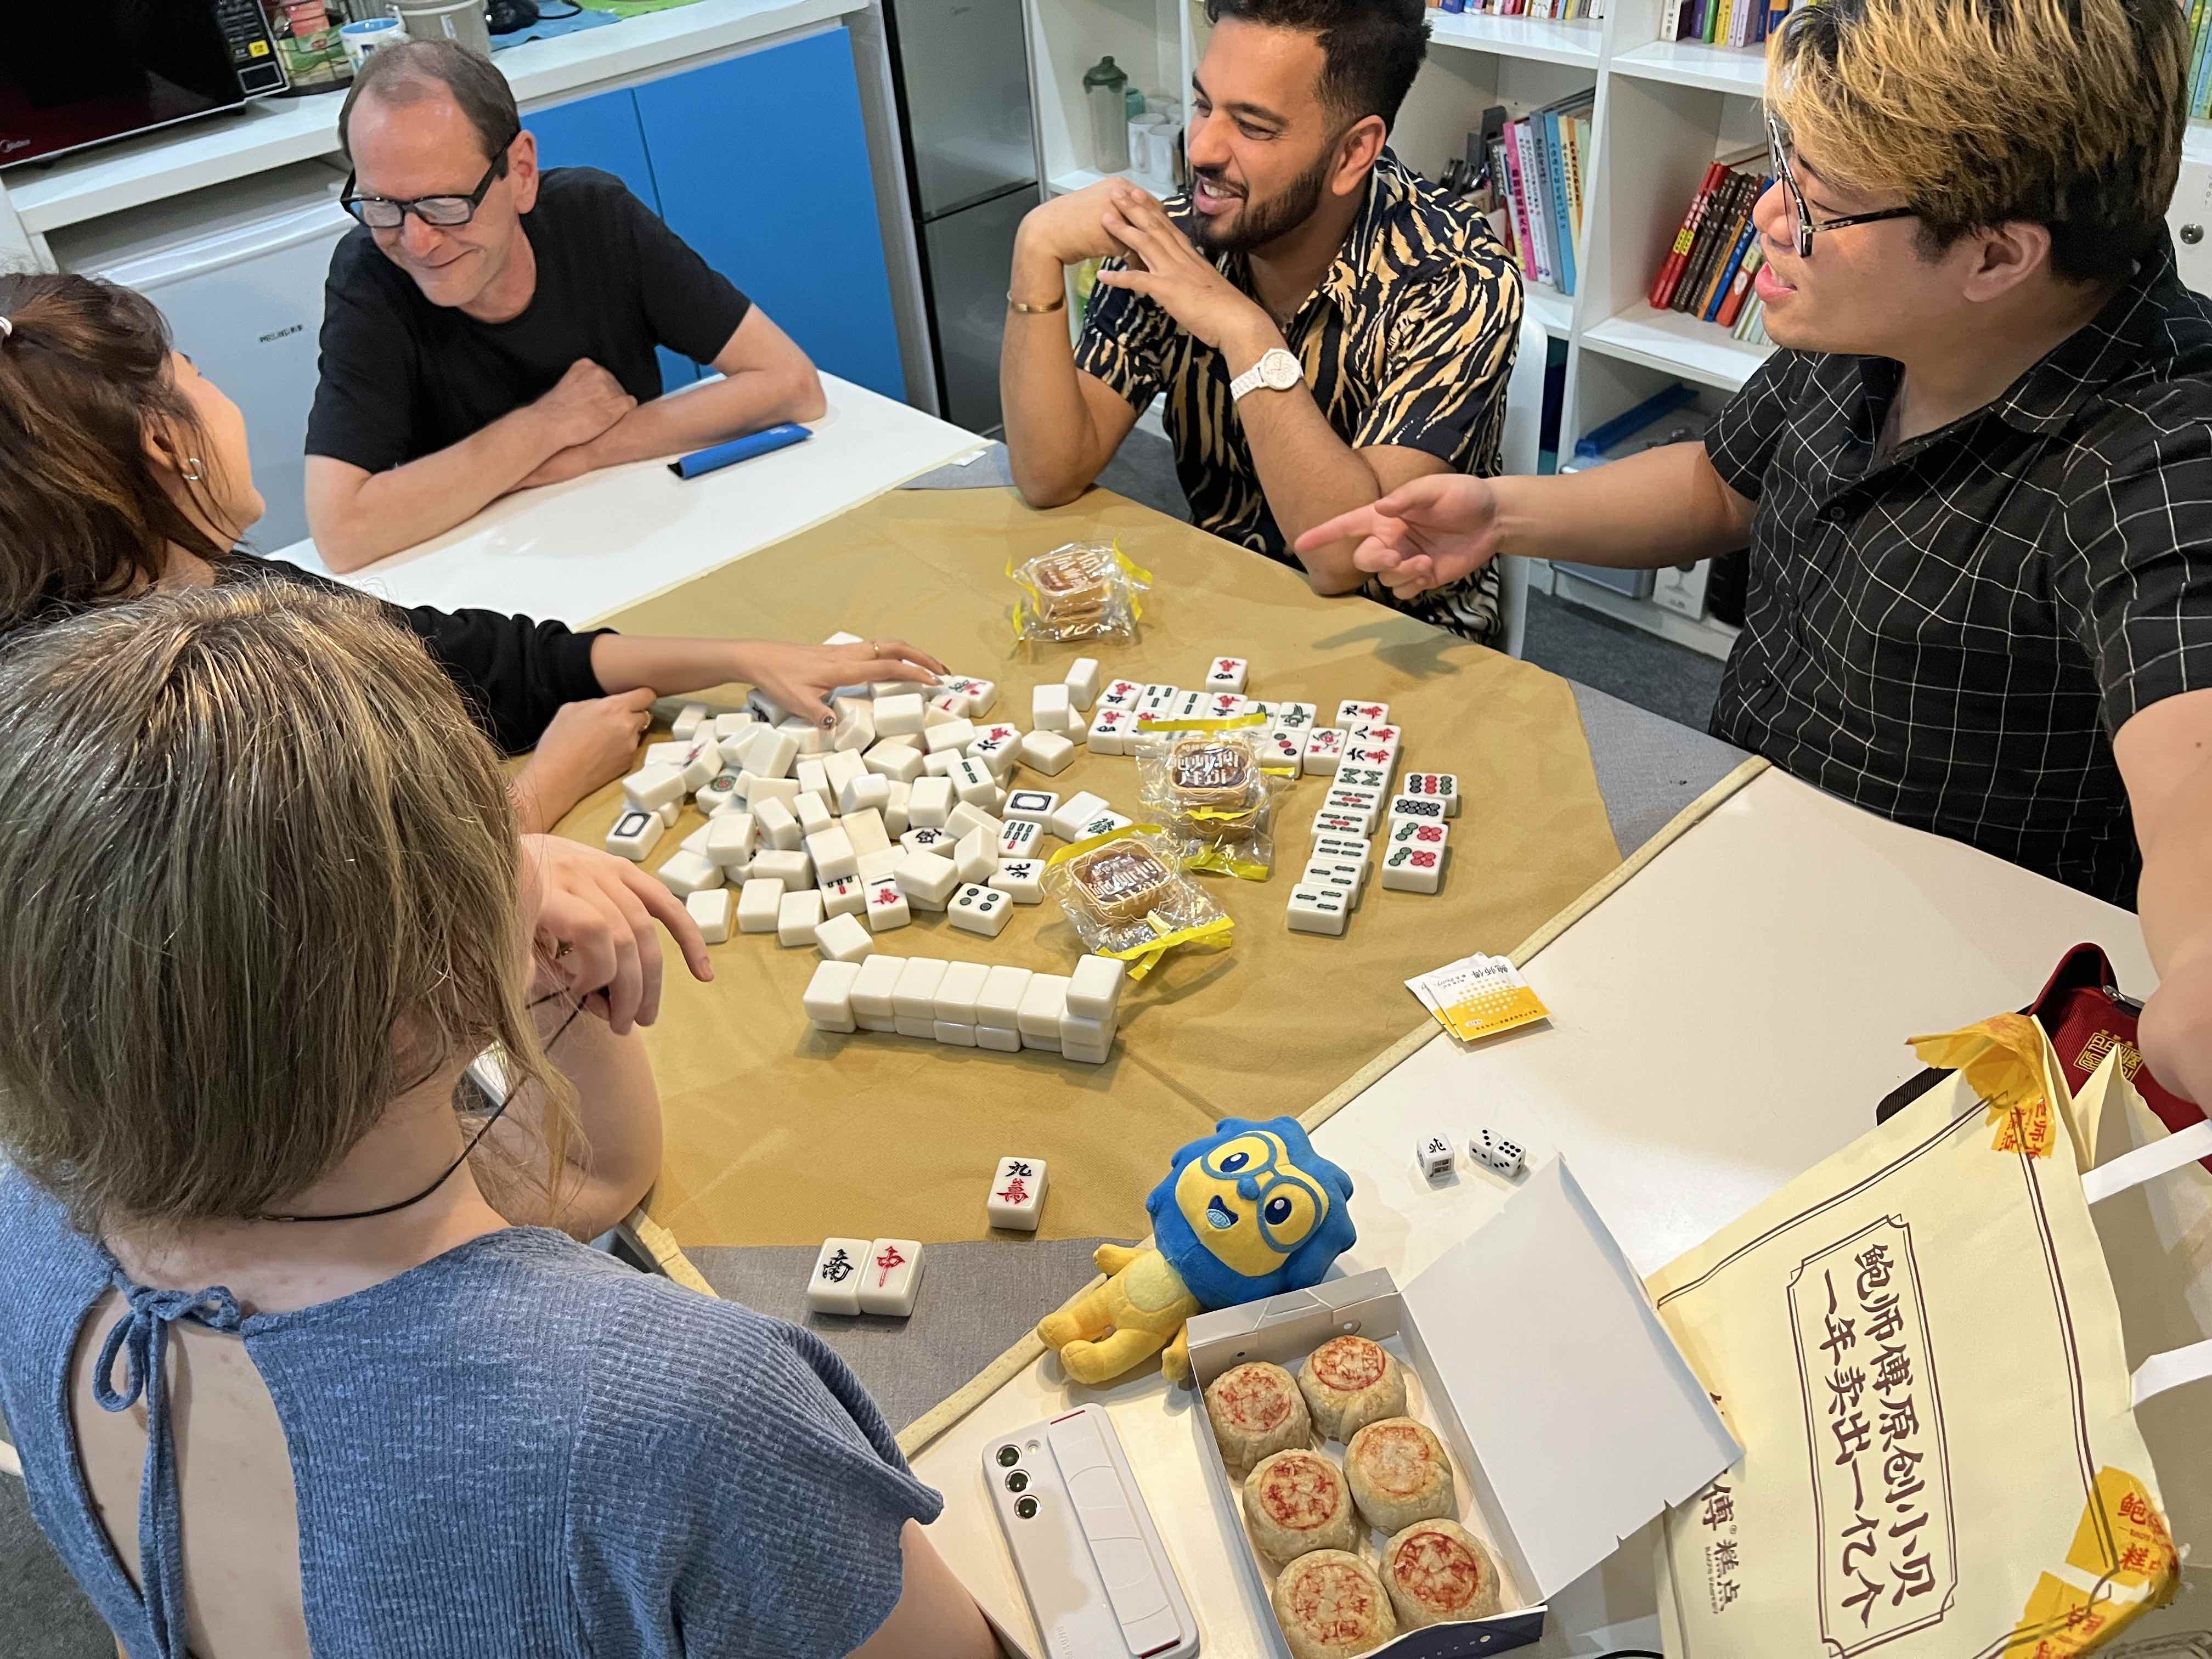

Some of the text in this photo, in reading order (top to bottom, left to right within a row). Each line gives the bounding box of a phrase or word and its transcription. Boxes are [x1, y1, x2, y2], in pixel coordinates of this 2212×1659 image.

[1005, 863, 1031, 879] 北
[1429, 1137, 1447, 1153] 北
[997, 1161, 1032, 1204] 九萬
[822, 1249, 854, 1283] 南
[877, 1246, 906, 1288] 中
[1819, 1268, 1885, 1629] 一年卖出一亿个
